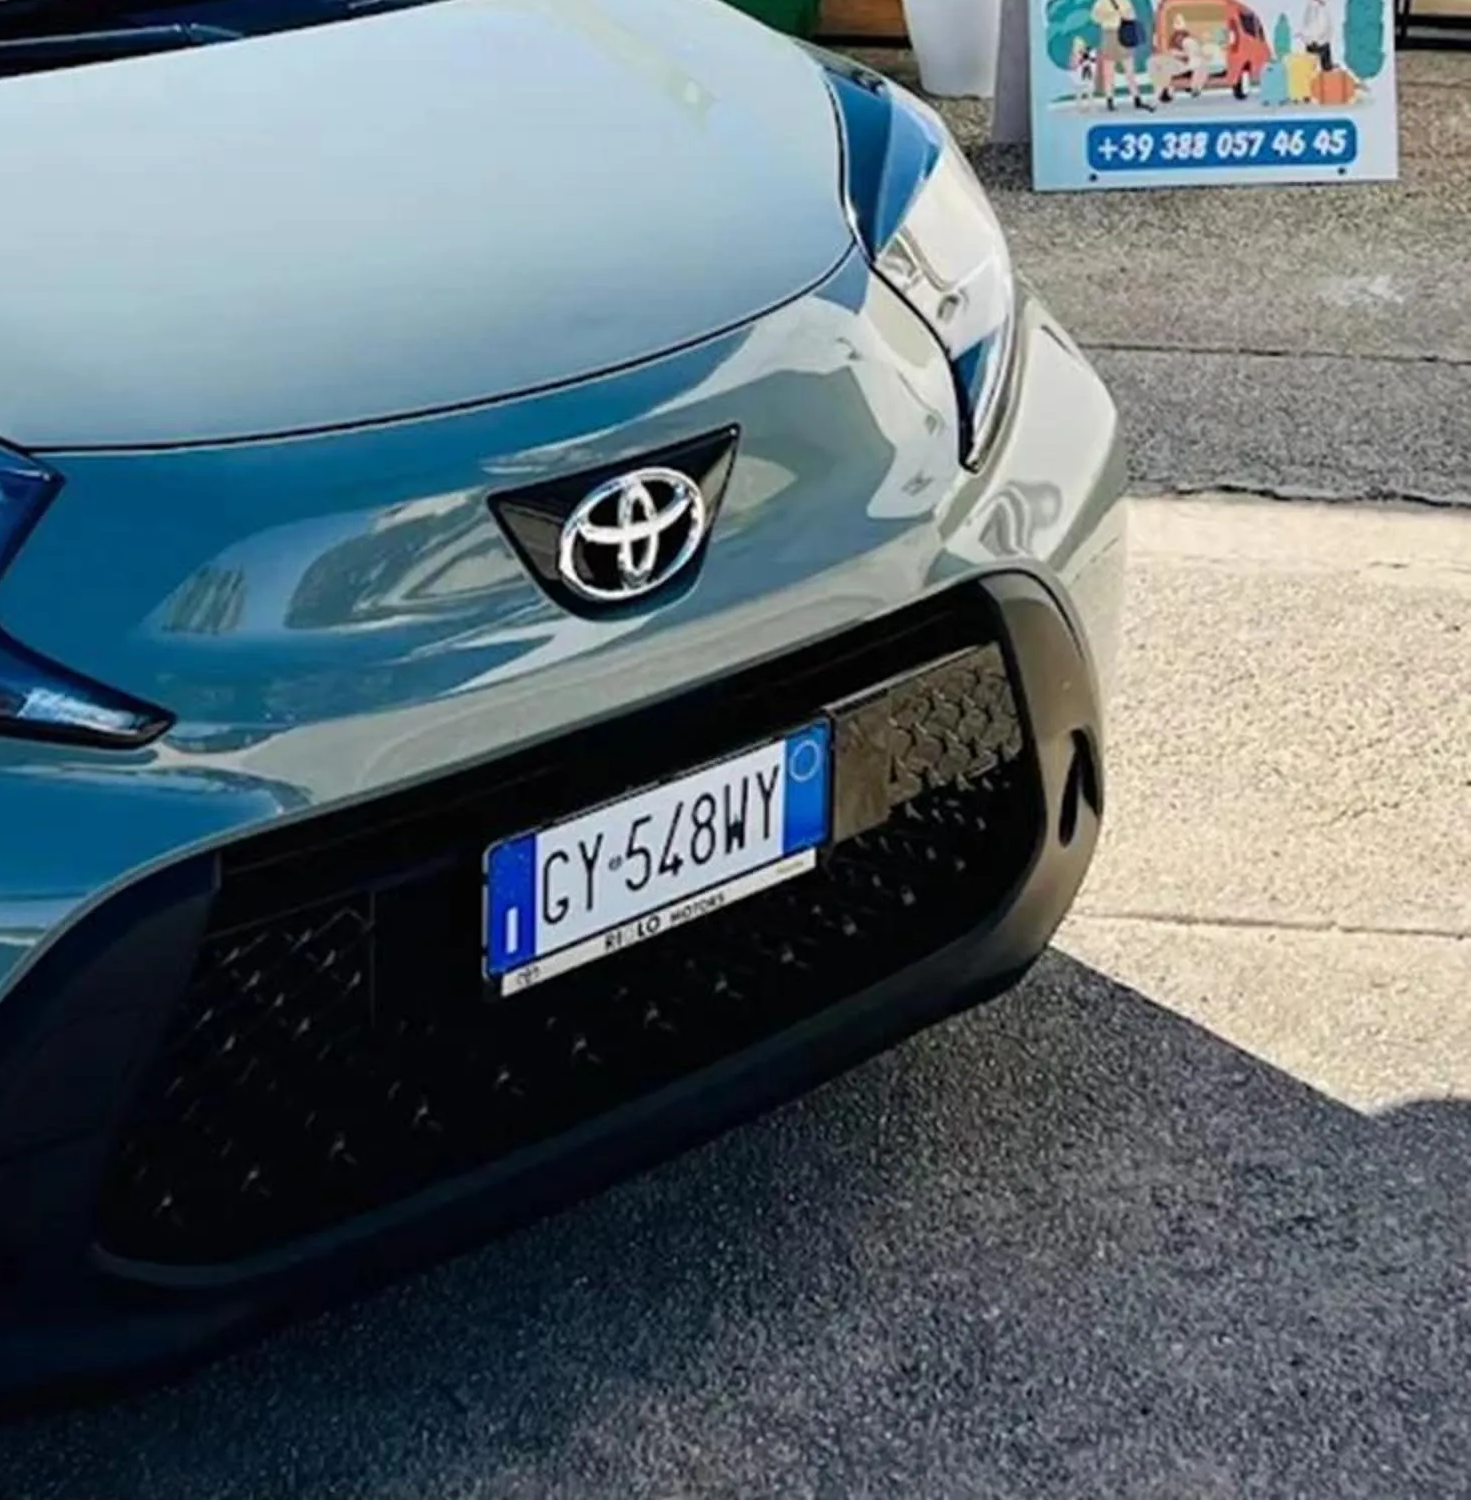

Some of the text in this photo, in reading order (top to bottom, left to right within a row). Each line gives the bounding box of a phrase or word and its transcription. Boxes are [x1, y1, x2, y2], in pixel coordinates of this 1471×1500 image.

[1097, 128, 1348, 163] +39 388 057 46 45
